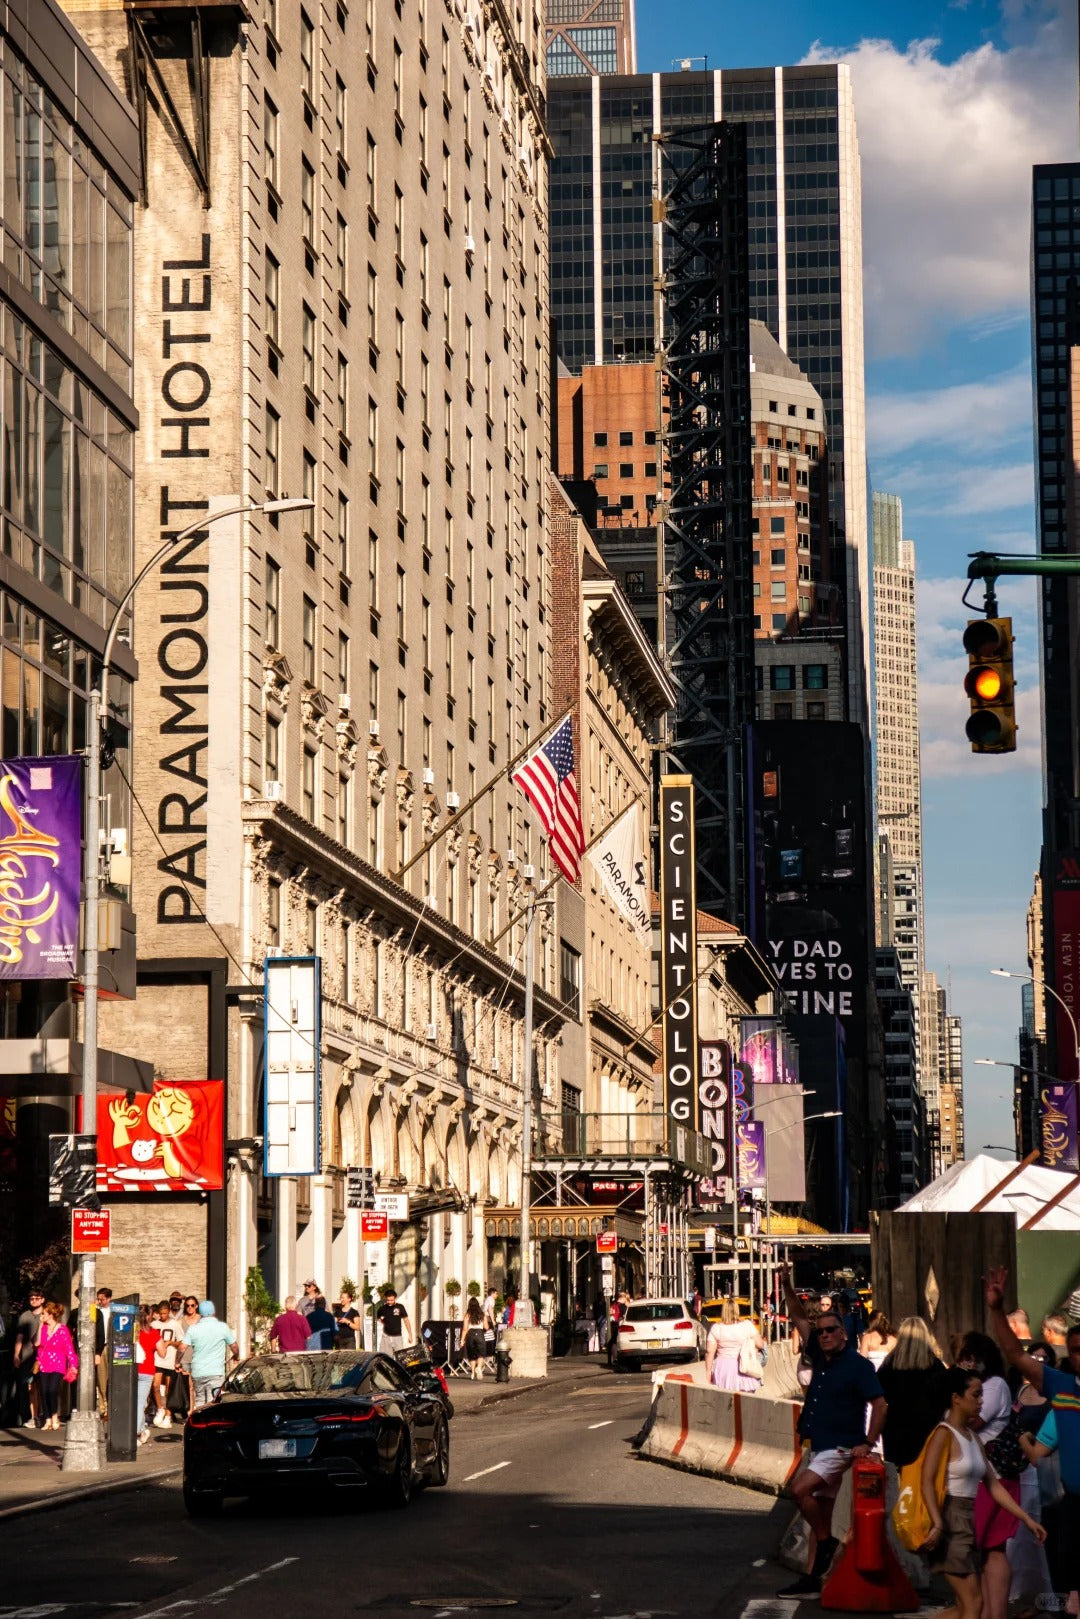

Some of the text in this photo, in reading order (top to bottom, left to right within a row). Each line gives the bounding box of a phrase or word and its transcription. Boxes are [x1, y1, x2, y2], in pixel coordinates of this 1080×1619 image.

[156, 233, 211, 925] PARAMOUNT HOTEL
[602, 851, 653, 933] PARAMOUNT
[668, 800, 692, 1121] SCIENTOLOG
[766, 940, 842, 958] Y DAD
[771, 962, 853, 981] VES TO
[1061, 933, 1073, 966] NEW
[698, 1047, 728, 1172] BOND
[1041, 1088, 1069, 1166] Aladdin
[79, 1220, 104, 1228] ANYTIME
[119, 1316, 129, 1331] P
